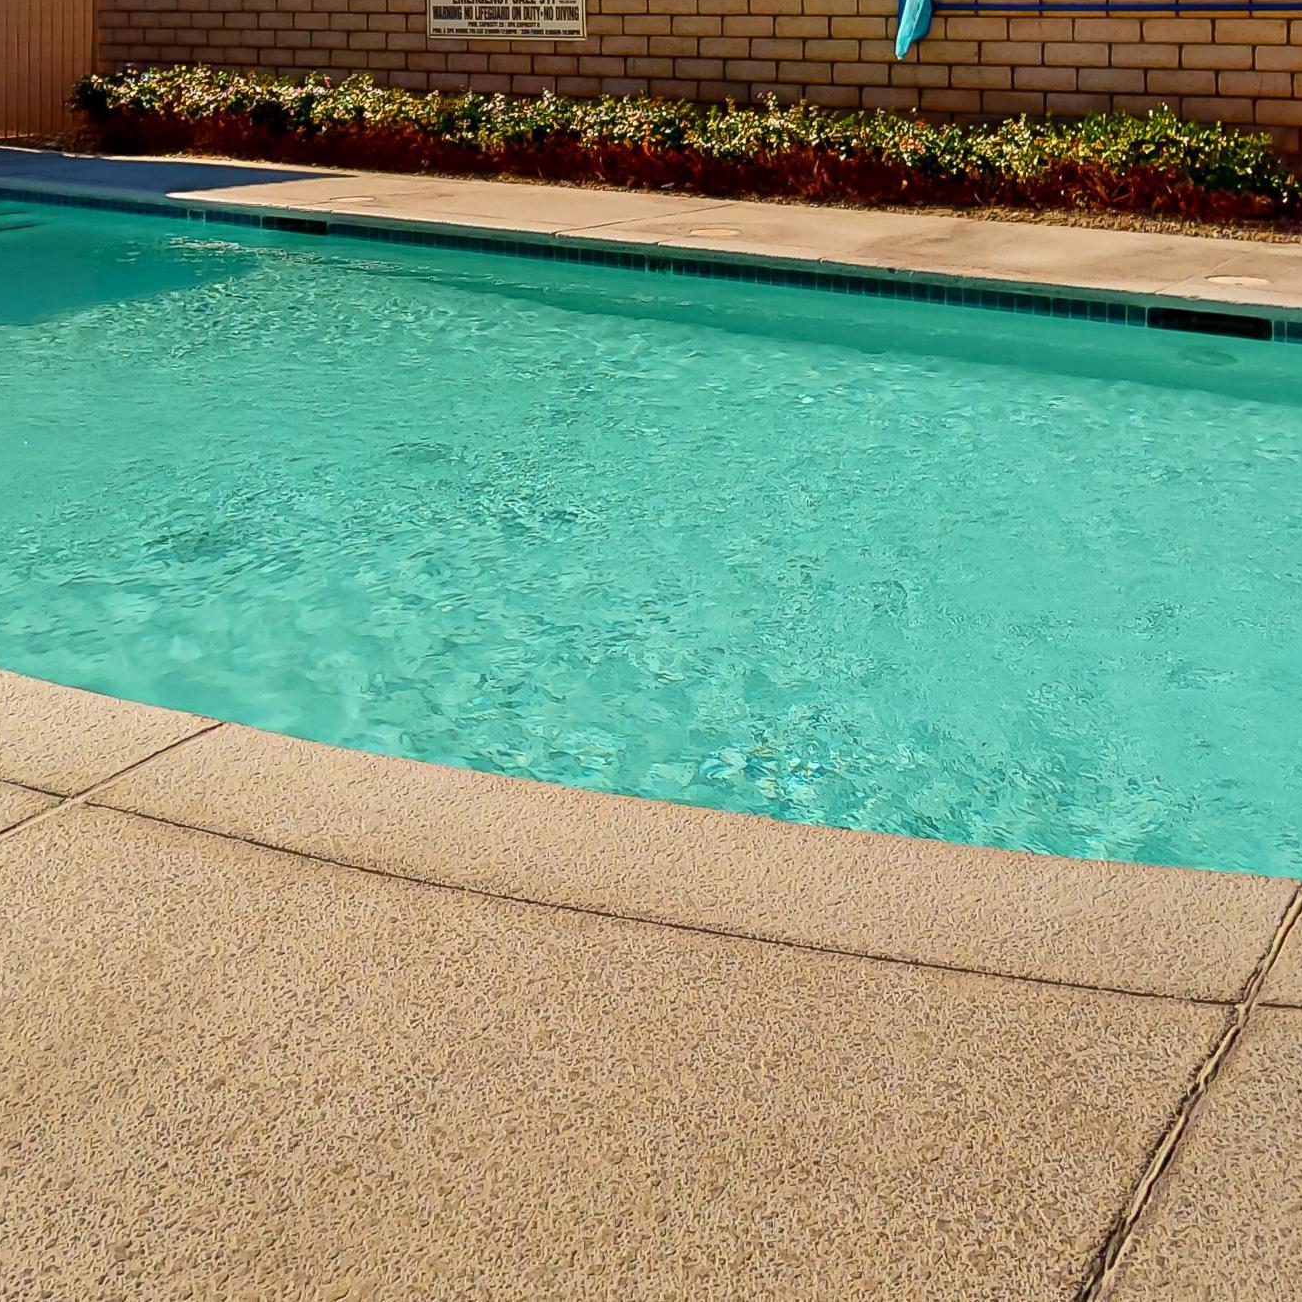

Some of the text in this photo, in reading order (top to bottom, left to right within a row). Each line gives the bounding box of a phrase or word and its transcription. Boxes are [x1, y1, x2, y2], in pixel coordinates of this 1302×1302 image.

[464, 6, 473, 20] NO
[475, 6, 509, 20] LIFEGUARD
[511, 6, 521, 20] ON
[523, 6, 540, 21] DUTY
[543, 6, 554, 21] NO
[555, 6, 579, 21] DIVING
